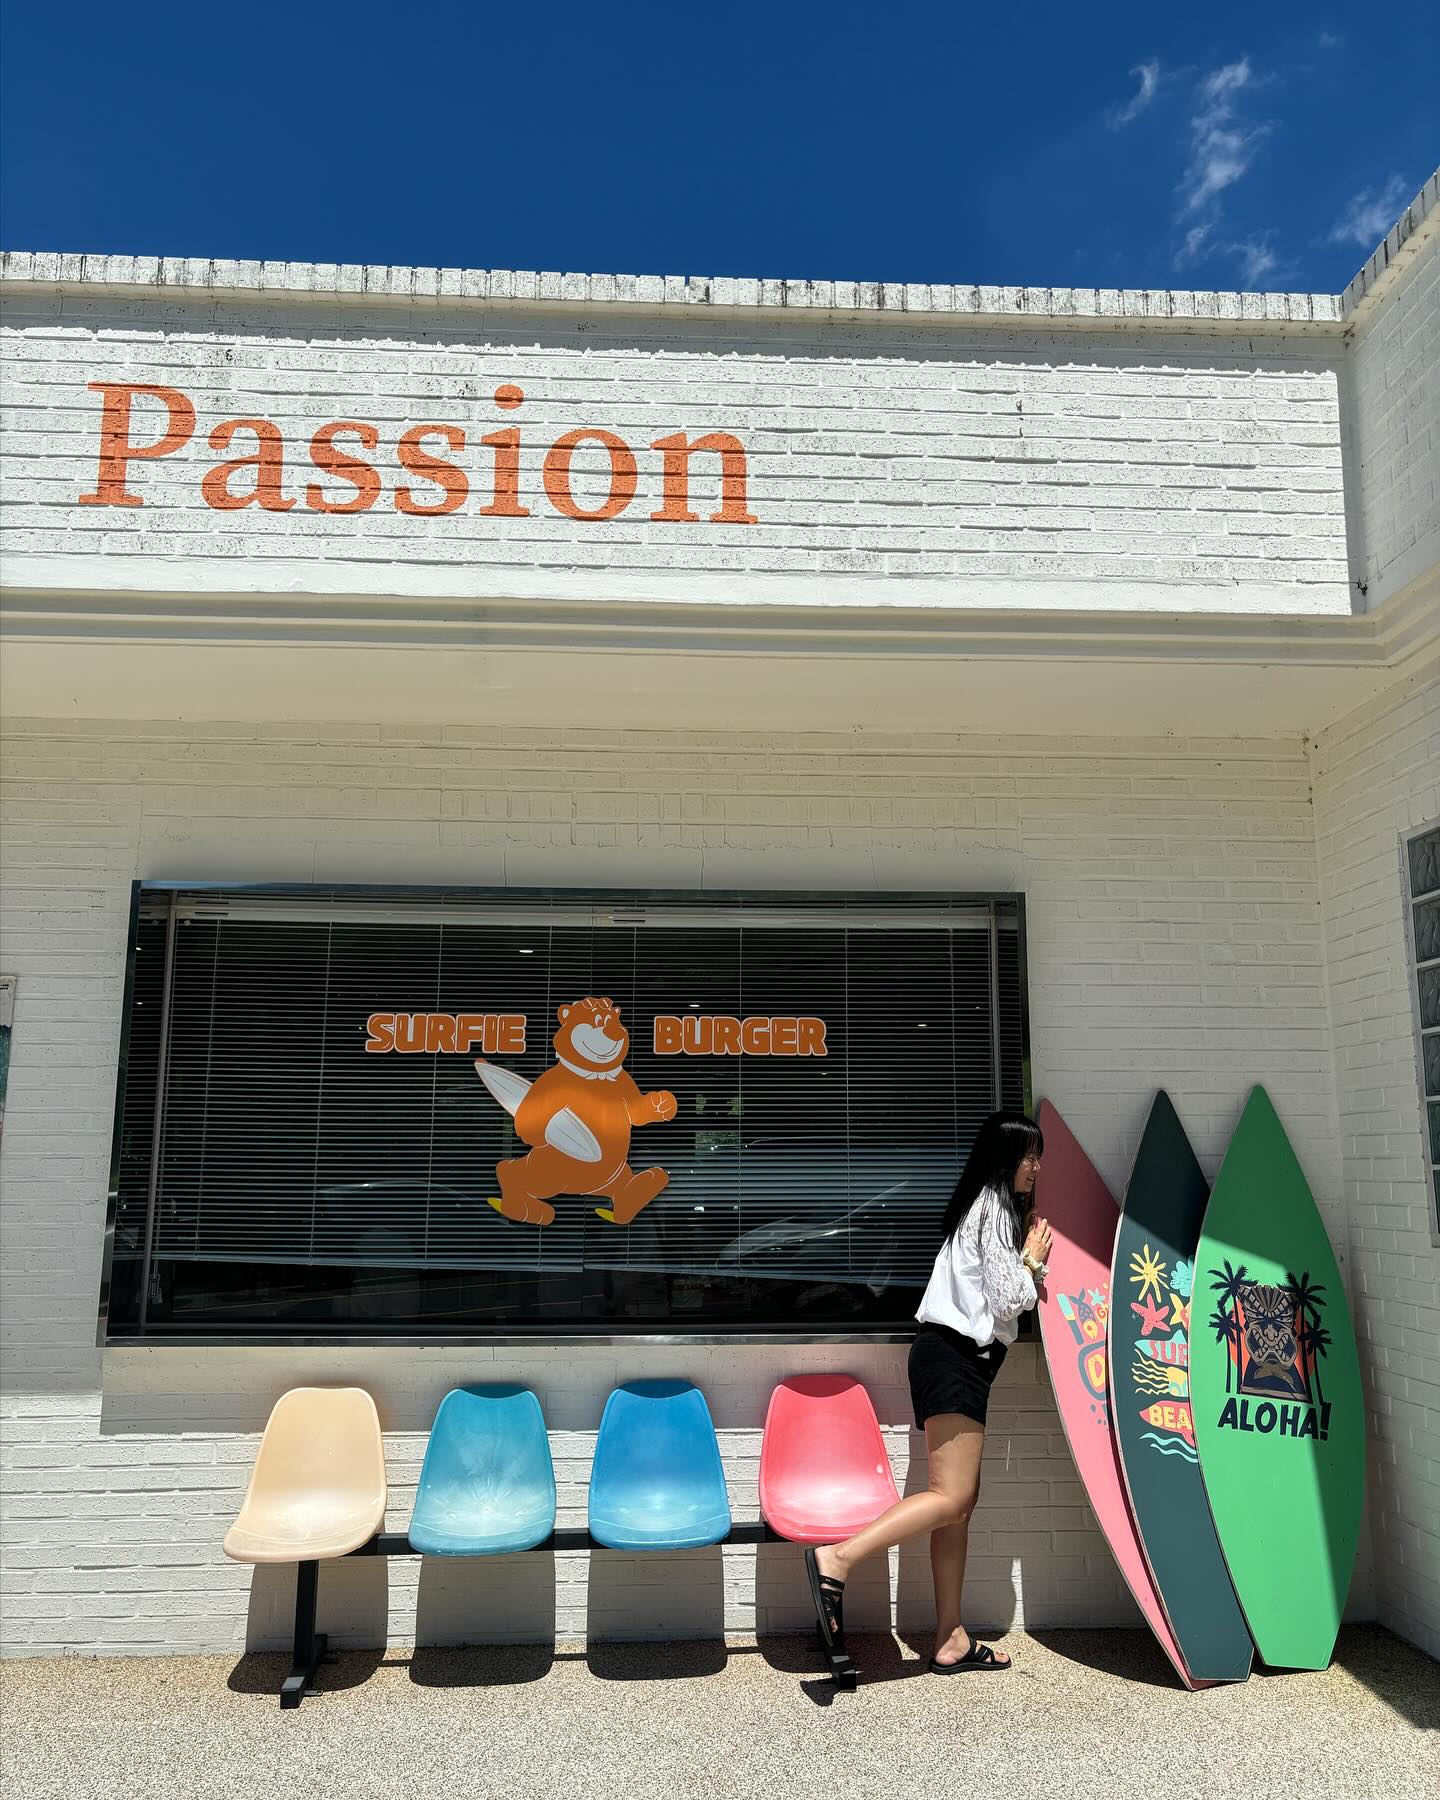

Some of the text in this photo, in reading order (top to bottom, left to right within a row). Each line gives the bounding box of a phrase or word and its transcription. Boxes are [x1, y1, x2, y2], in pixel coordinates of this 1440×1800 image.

[78, 381, 759, 525] Passion
[365, 1012, 829, 1057] SURFIE BURGER
[1217, 1397, 1332, 1441] ALOHA!
